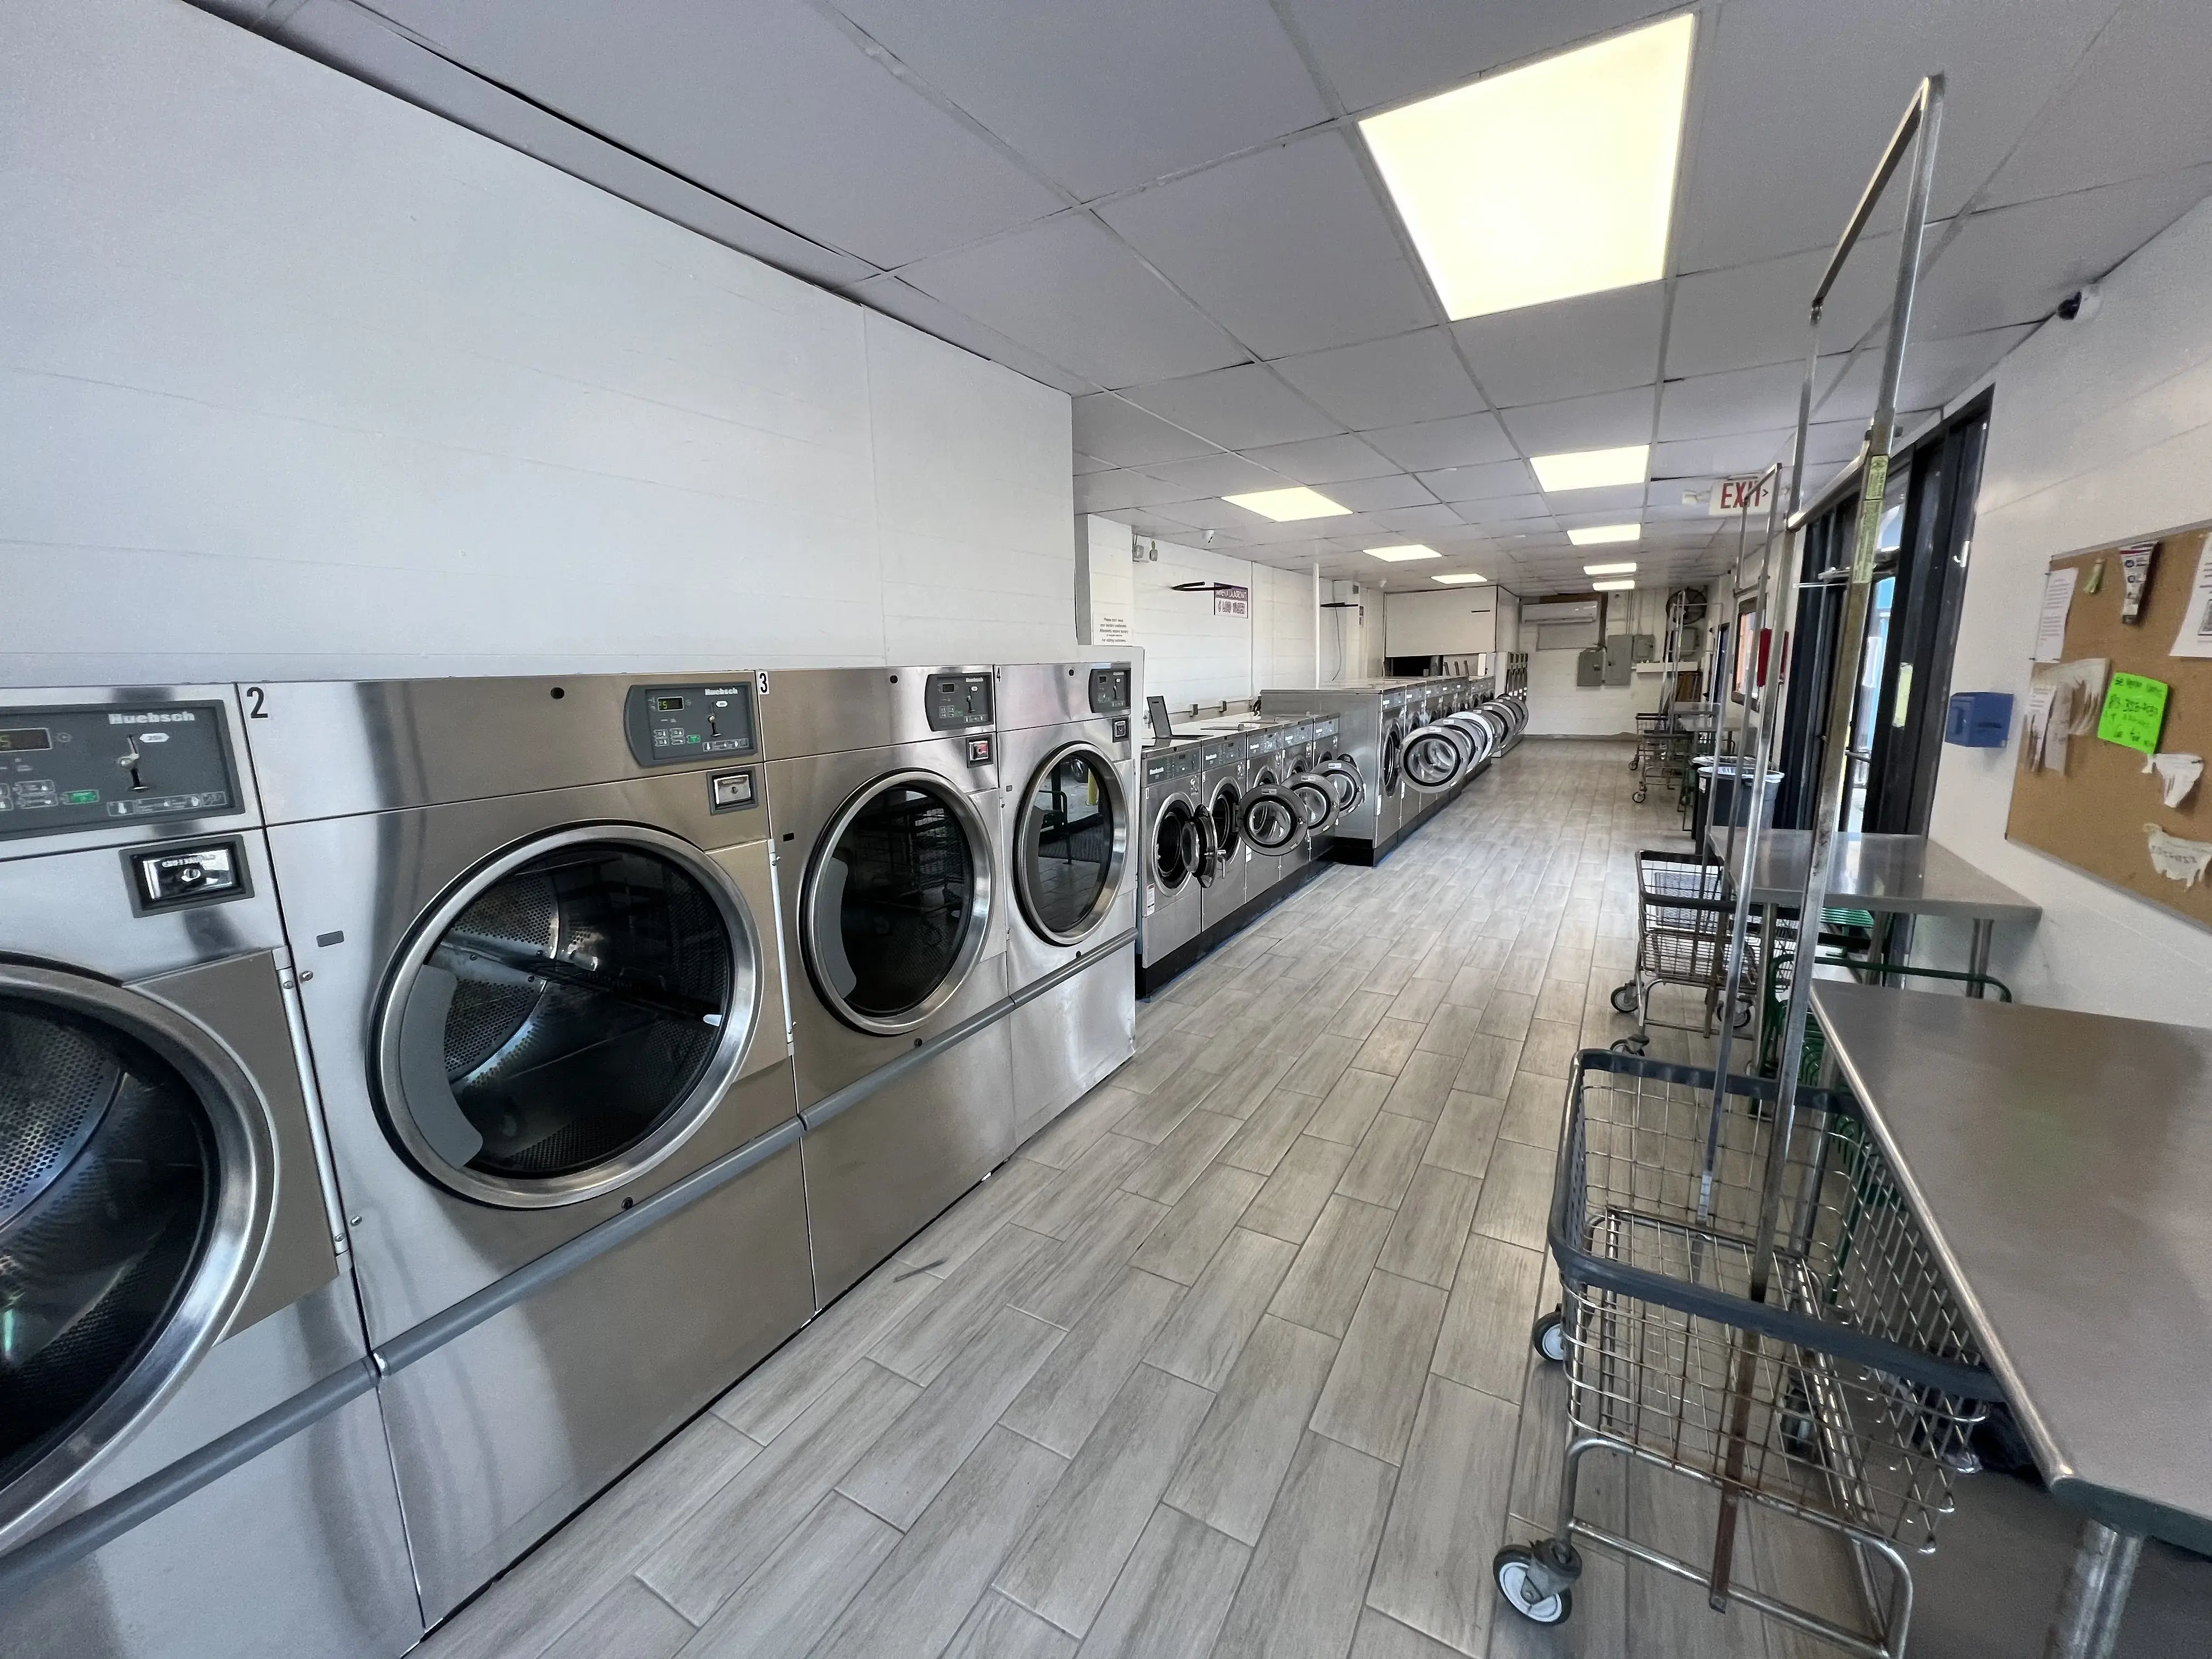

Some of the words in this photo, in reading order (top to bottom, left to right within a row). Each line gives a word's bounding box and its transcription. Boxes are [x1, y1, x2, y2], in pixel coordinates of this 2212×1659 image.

[996, 667, 1001, 682] 4
[759, 673, 768, 693] 3
[704, 687, 738, 696] Huebsch
[247, 686, 268, 719] 2
[109, 711, 195, 724] Huebsch
